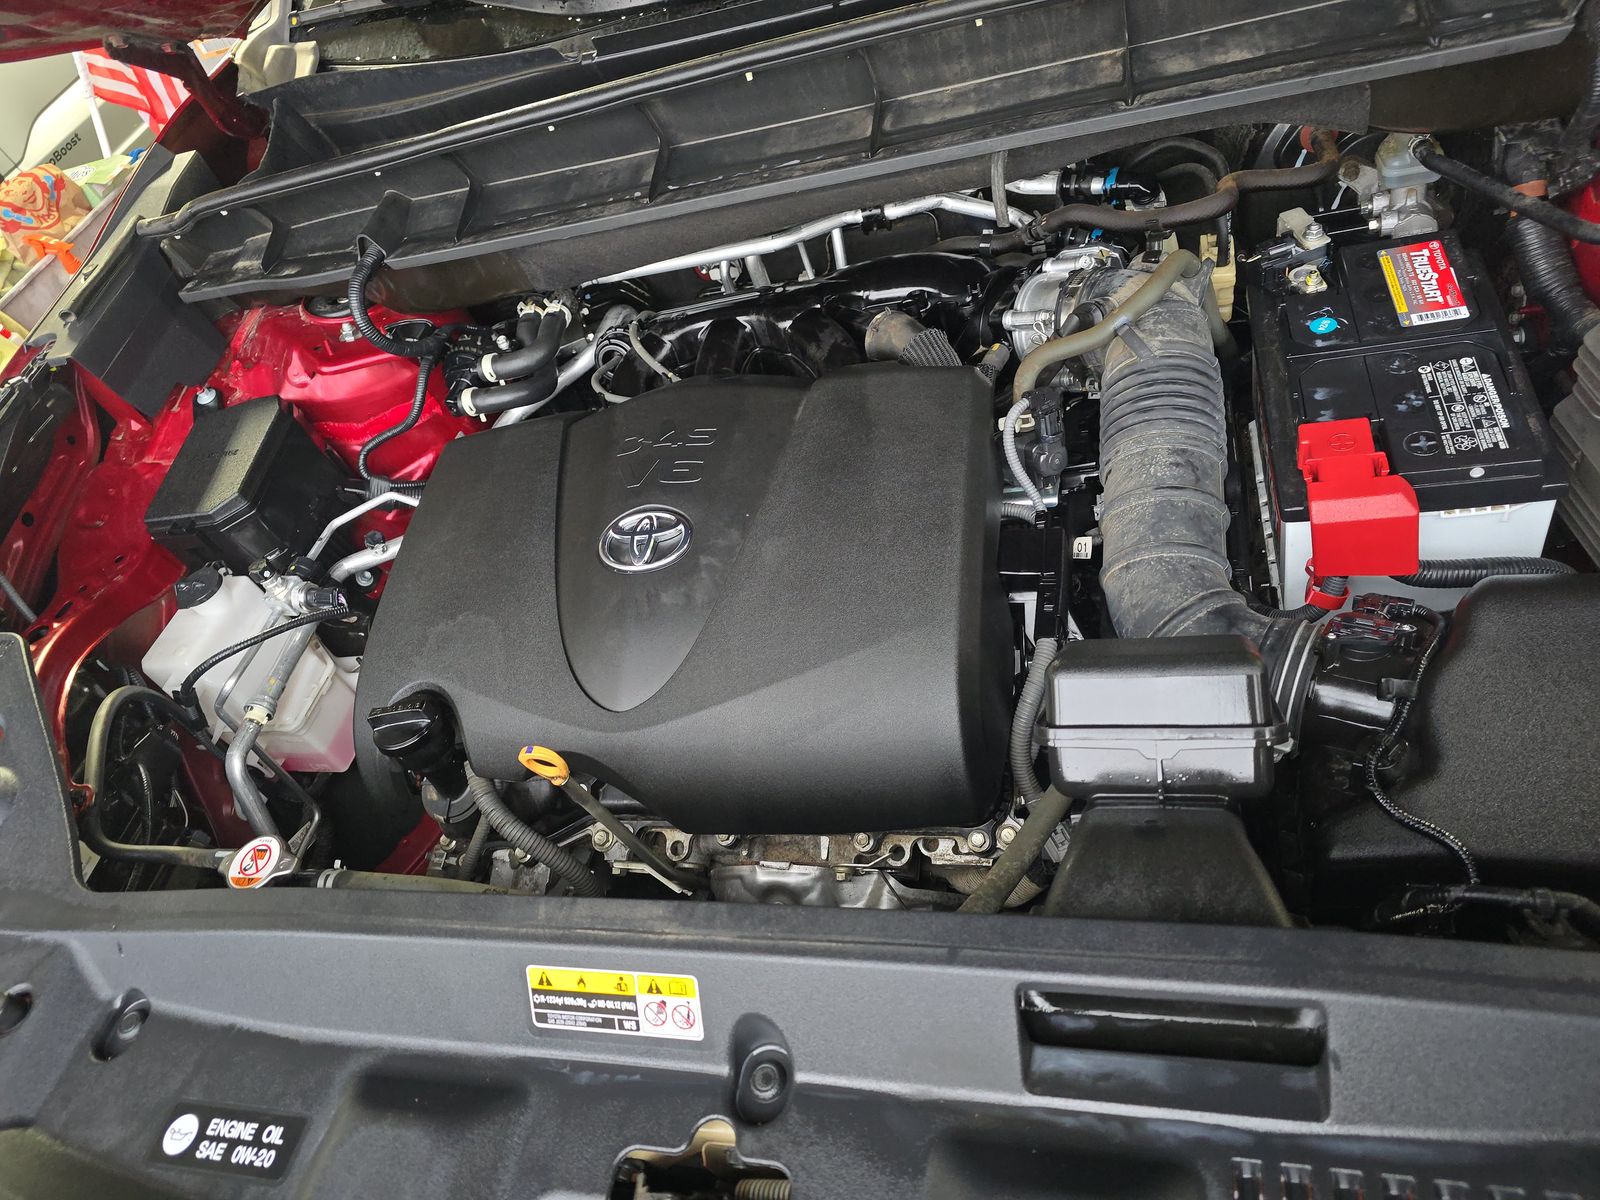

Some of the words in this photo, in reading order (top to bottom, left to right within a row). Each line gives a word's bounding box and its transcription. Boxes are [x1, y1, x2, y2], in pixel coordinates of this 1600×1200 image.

[1433, 249, 1446, 270] TOYOTA
[1484, 378, 1510, 428] DANGER/POISON
[618, 458, 705, 489] V6
[1077, 542, 1087, 553] 01
[205, 1117, 259, 1141] ENGINE
[261, 1125, 284, 1145] OIL
[195, 1140, 228, 1161] SAE
[230, 1145, 276, 1168] 0W-20
